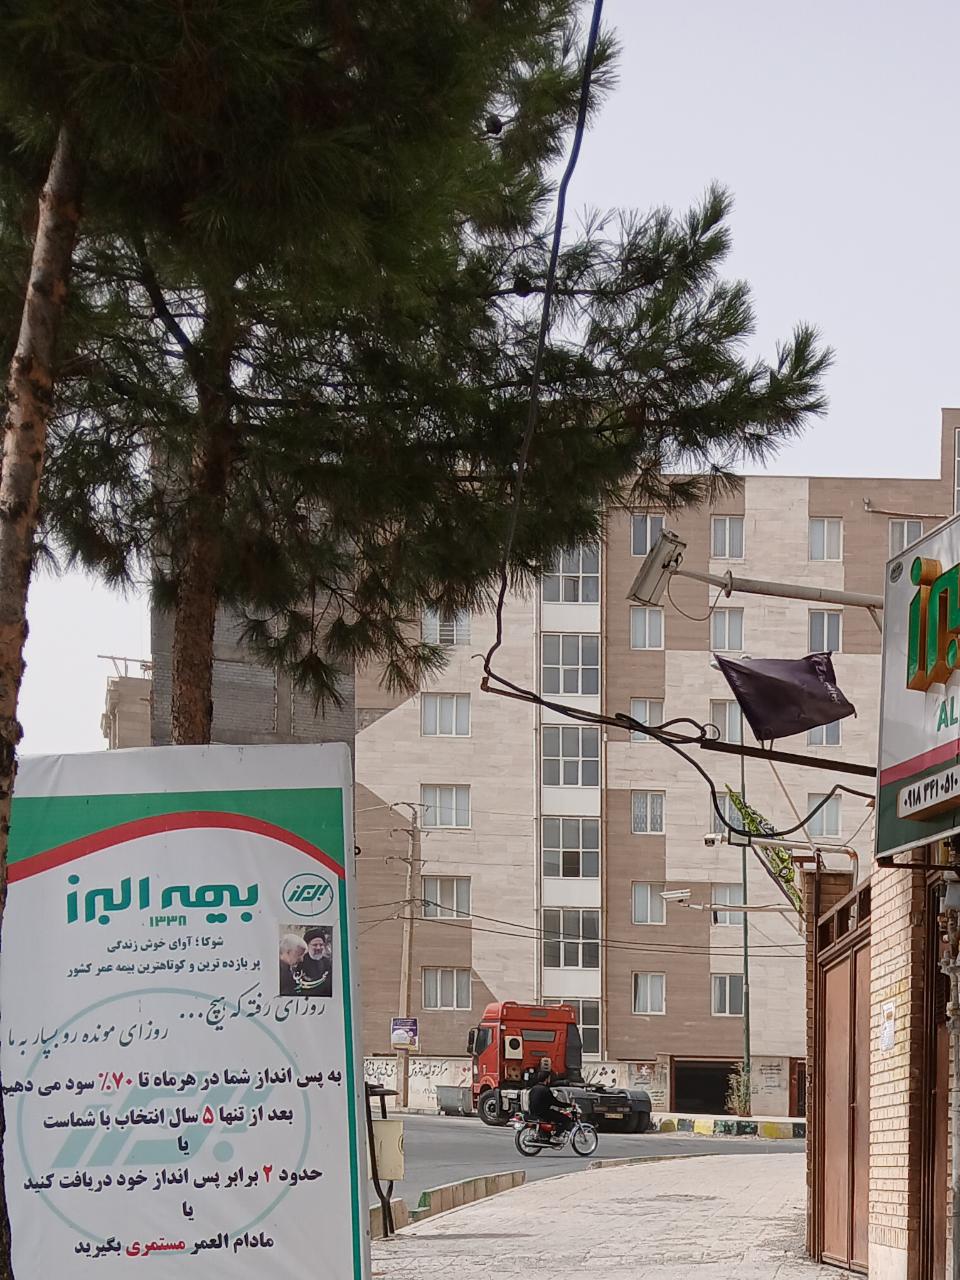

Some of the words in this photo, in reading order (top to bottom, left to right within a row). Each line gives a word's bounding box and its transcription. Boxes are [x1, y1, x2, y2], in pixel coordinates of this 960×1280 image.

[66, 874, 150, 926] البرز
[161, 883, 259, 924] بیمه
[138, 1071, 150, 1088] تا
[224, 1068, 251, 1086] شما
[255, 1067, 292, 1089] انداز
[296, 1073, 323, 1094] پس
[326, 1070, 343, 1089] به
[67, 1078, 95, 1096] سود
[43, 1112, 96, 1130] شماست
[115, 1109, 165, 1129] انتخاب
[169, 1108, 199, 1129] سال
[219, 1105, 244, 1122] تنها
[268, 1106, 294, 1125] بعد
[177, 1136, 189, 1156] یا
[59, 1174, 113, 1193] دریافت
[116, 1175, 148, 1191] خود
[152, 1169, 189, 1192] انداز
[279, 1170, 323, 1186] حدود
[182, 1201, 195, 1220] یا
[125, 1237, 187, 1257] مستمری
[190, 1233, 229, 1255] العمر
[233, 1232, 274, 1253] مادام
